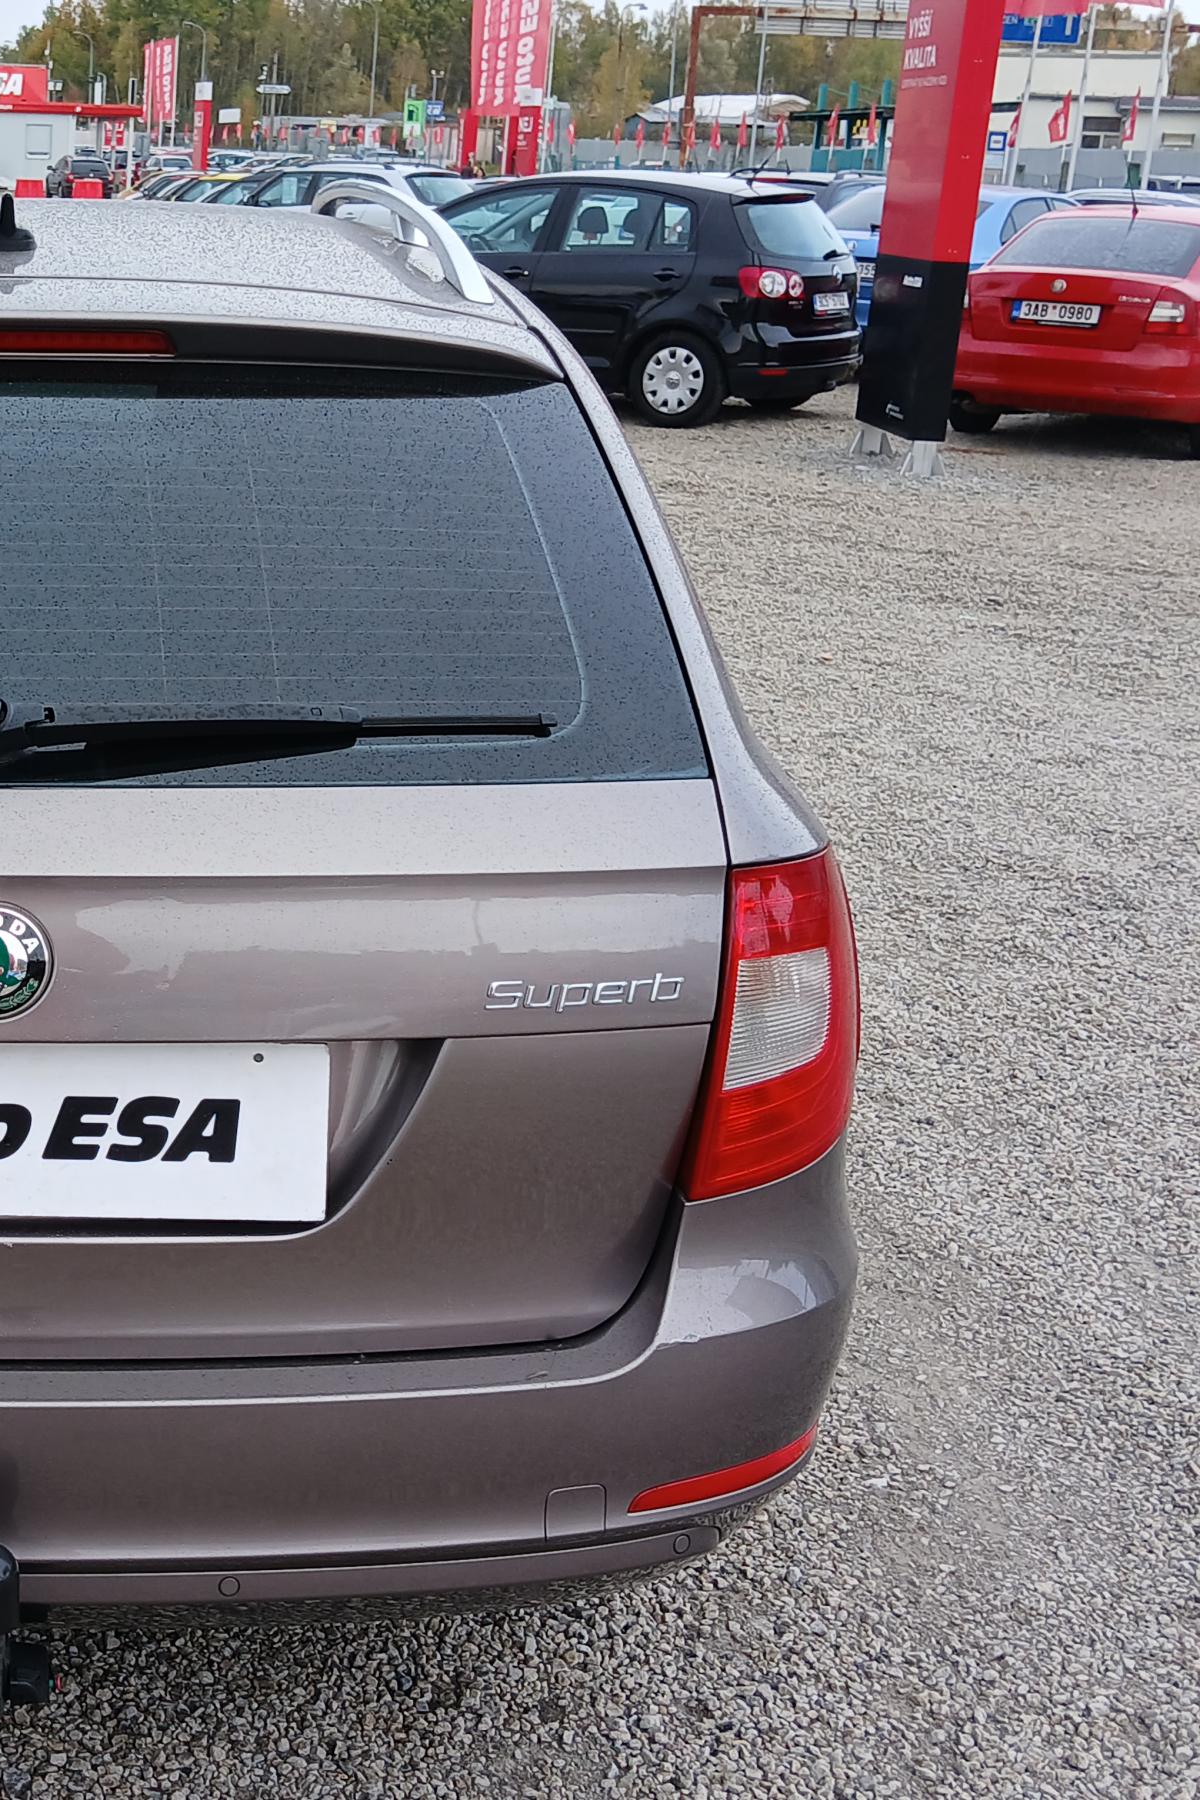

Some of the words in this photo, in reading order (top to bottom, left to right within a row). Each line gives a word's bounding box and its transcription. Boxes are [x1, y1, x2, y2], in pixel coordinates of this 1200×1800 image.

[1023, 302, 1049, 318] 3AB
[1058, 306, 1093, 320] 0980
[484, 972, 685, 1013] Superb
[42, 1095, 241, 1164] ESA
